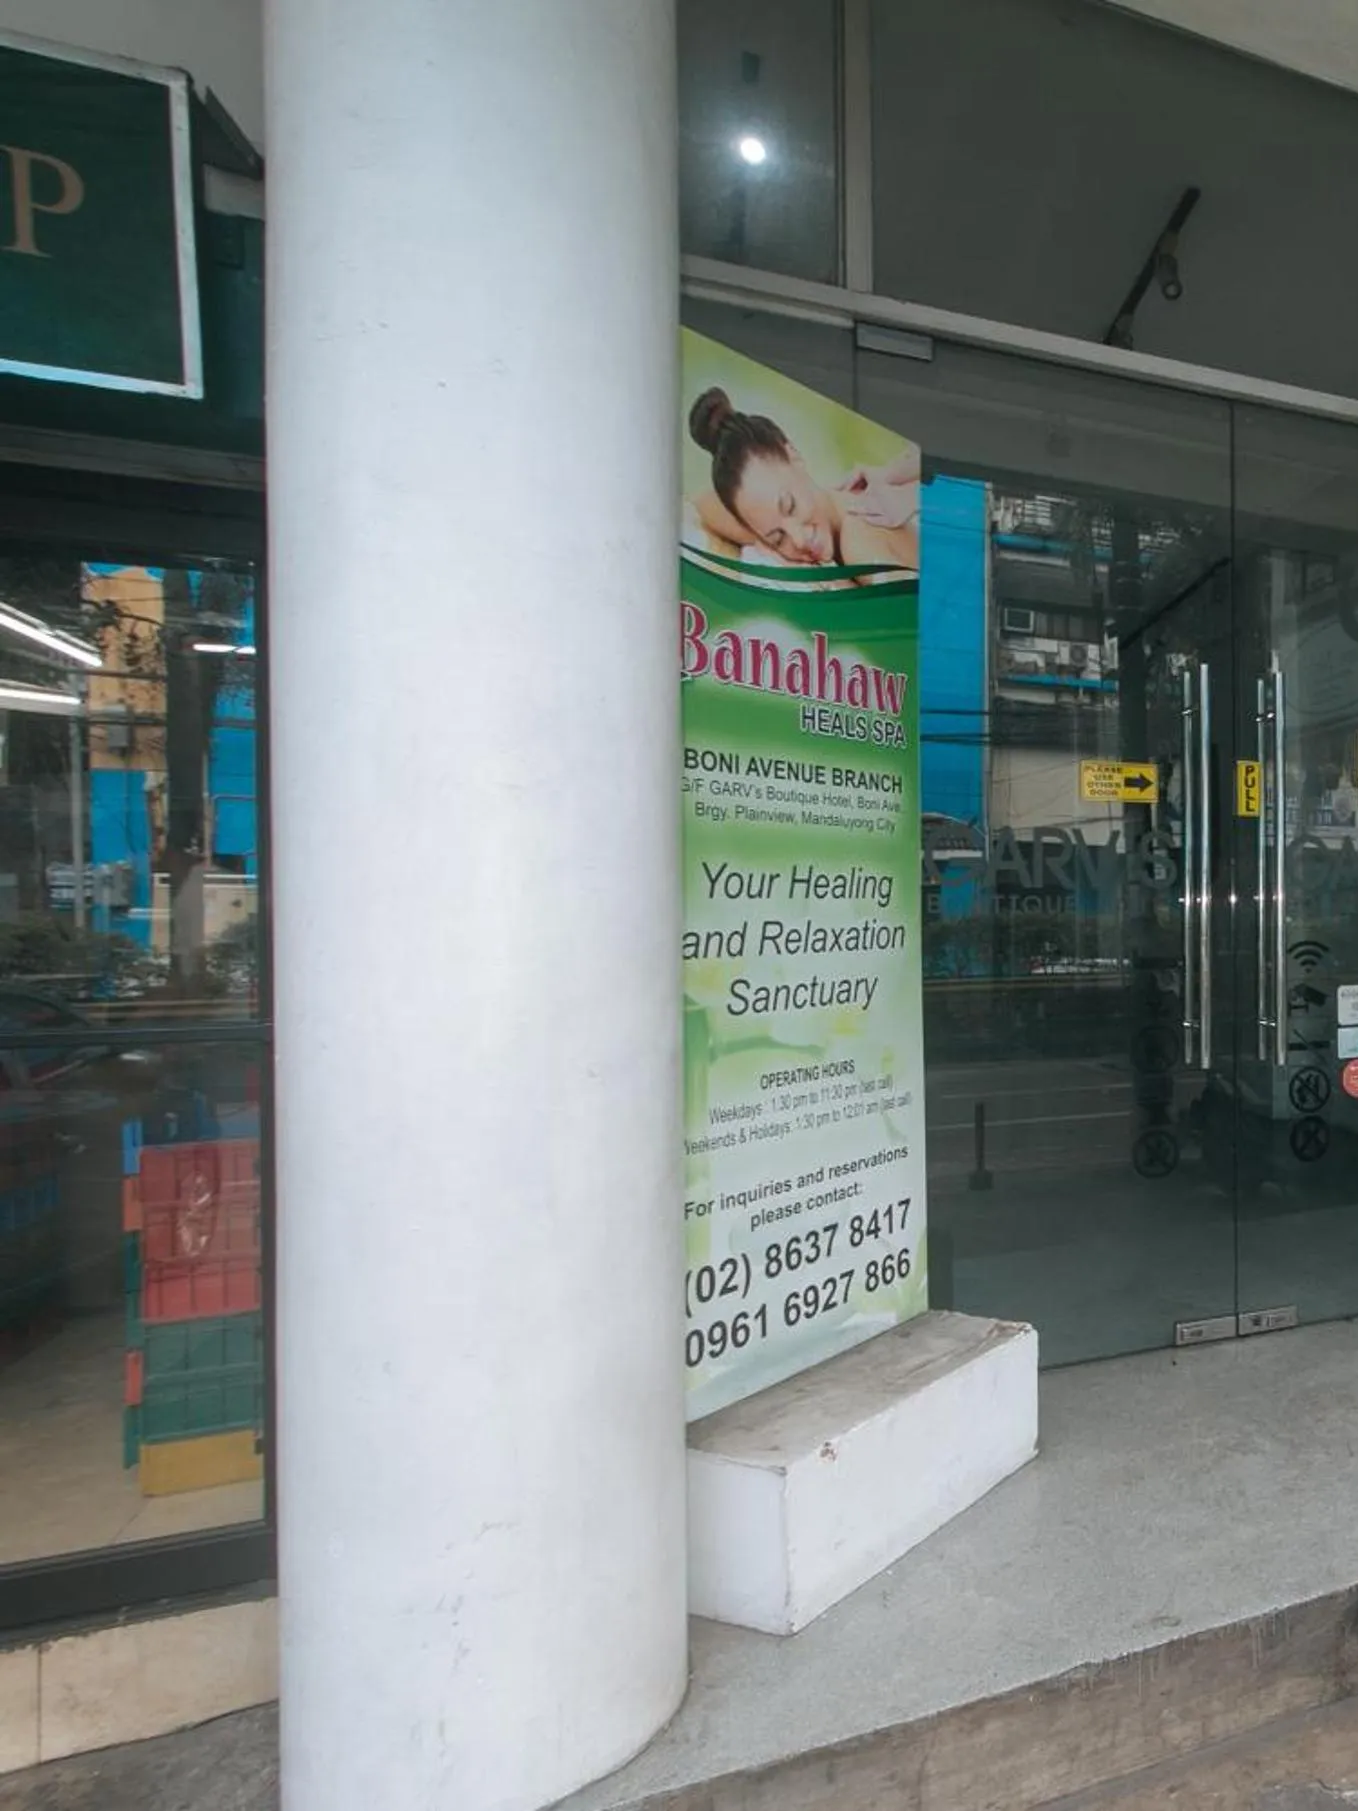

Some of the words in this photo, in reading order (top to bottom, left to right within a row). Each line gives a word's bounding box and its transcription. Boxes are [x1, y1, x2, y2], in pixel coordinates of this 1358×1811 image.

[1, 144, 86, 258] P
[681, 600, 909, 716] Banahaw
[802, 705, 868, 740] HEALS
[873, 716, 906, 746] SPA
[684, 748, 740, 774] BONI
[745, 756, 827, 785] AVENUE
[832, 767, 903, 794] BRANCH
[1083, 764, 1123, 774] PLEASE
[1086, 781, 1122, 789] OTHER
[1244, 764, 1256, 812] PULL
[766, 785, 820, 807] Boutique
[1089, 788, 1119, 796] DOOR
[801, 810, 875, 833] Mandaluyong
[877, 817, 896, 833] City
[701, 861, 781, 900] Your
[788, 865, 894, 908] Healing
[682, 920, 748, 960] and
[758, 918, 906, 956] Relaxation
[727, 975, 879, 1016] Sanctuary
[760, 1065, 820, 1090] OPERATING
[822, 1059, 855, 1079] HOURS
[684, 1199, 715, 1221] For
[719, 1177, 793, 1211] inquiries
[797, 1167, 824, 1189] and
[829, 1145, 909, 1180] reservations
[750, 1199, 803, 1232] please
[806, 1180, 863, 1211] contact:
[685, 1252, 752, 1318] (02)
[764, 1222, 840, 1279] 8637
[849, 1198, 912, 1248] 8417
[685, 1302, 768, 1368] 0961
[783, 1268, 855, 1327] 6927
[864, 1247, 911, 1293] 866
